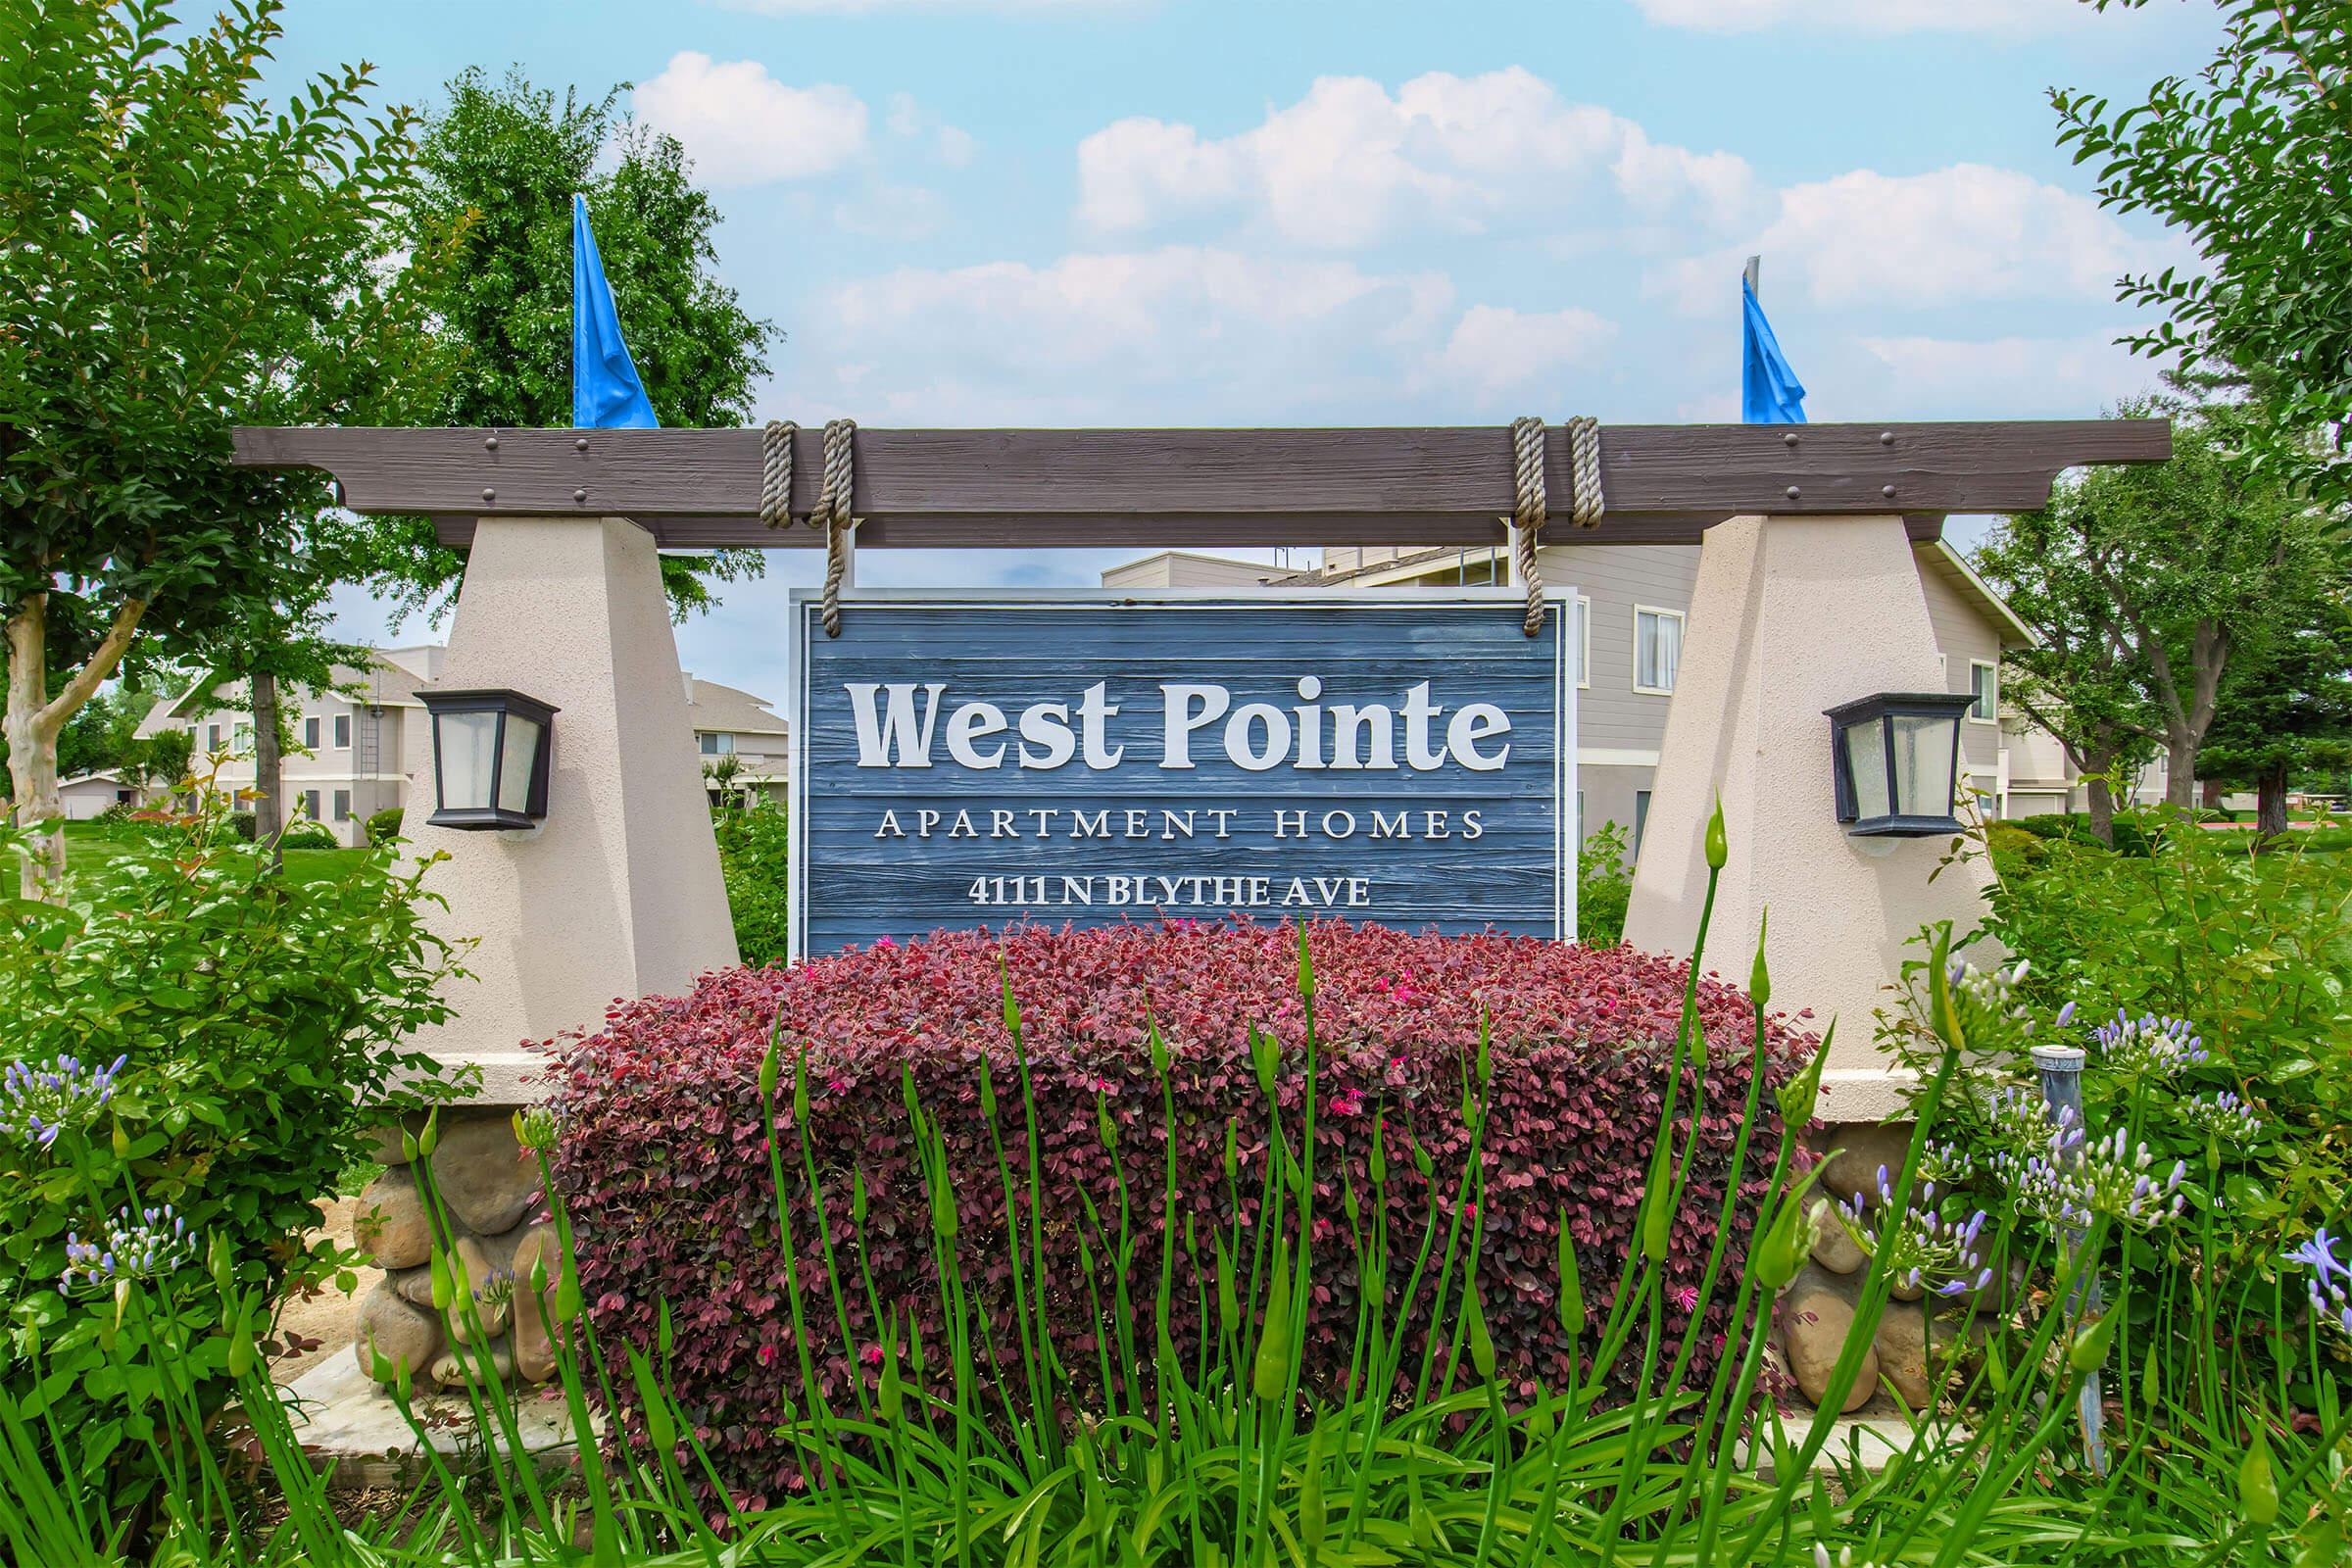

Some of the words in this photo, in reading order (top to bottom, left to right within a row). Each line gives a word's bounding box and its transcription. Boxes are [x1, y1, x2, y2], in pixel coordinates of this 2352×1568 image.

[843, 679, 1125, 770] West
[1158, 674, 1513, 771] Pointe
[873, 808, 1239, 840] APARTMENT
[1273, 808, 1485, 840] HOMES
[967, 875, 1052, 906] 4111
[1059, 875, 1095, 906] N
[1104, 875, 1272, 906] BLYTHE
[1280, 875, 1371, 907] AVE
